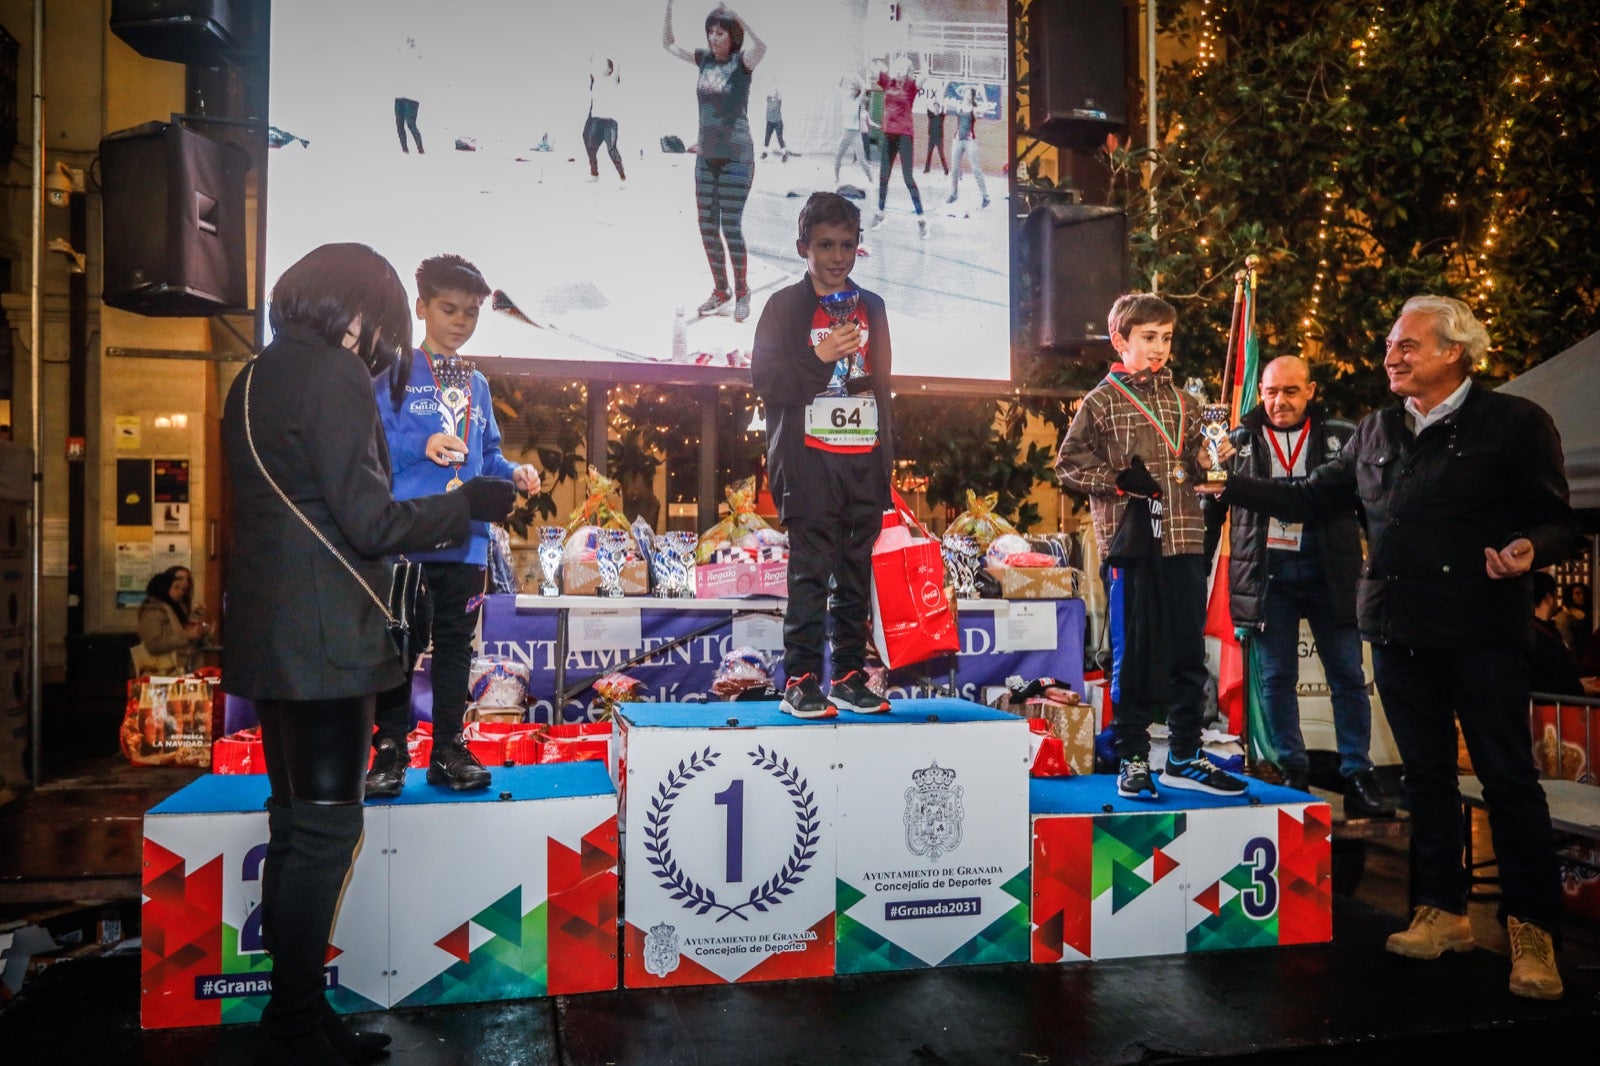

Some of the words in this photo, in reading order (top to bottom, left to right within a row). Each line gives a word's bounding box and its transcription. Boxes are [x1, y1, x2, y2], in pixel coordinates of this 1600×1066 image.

[831, 407, 862, 428] 64
[707, 567, 737, 582] Regalo
[764, 569, 788, 582] Regal
[152, 740, 164, 748] LA
[165, 740, 204, 748] NAVIDAD
[714, 779, 744, 884] 1
[862, 868, 940, 881] AYUNTAMIENTO
[942, 868, 955, 877] DE
[956, 865, 1003, 876] GRANADA
[1242, 836, 1277, 918] 3
[874, 878, 930, 892] Concejalía
[932, 878, 946, 888] de
[948, 876, 992, 889] Deportes
[890, 901, 977, 917] #Granada2031
[683, 935, 757, 946] AYUNTAMIENTO
[759, 934, 770, 943] DE
[772, 931, 817, 942] GRANADA
[694, 942, 747, 956] Concejalía
[749, 943, 762, 953] de
[764, 941, 806, 953] Deportes
[202, 972, 331, 995] #Grana1
